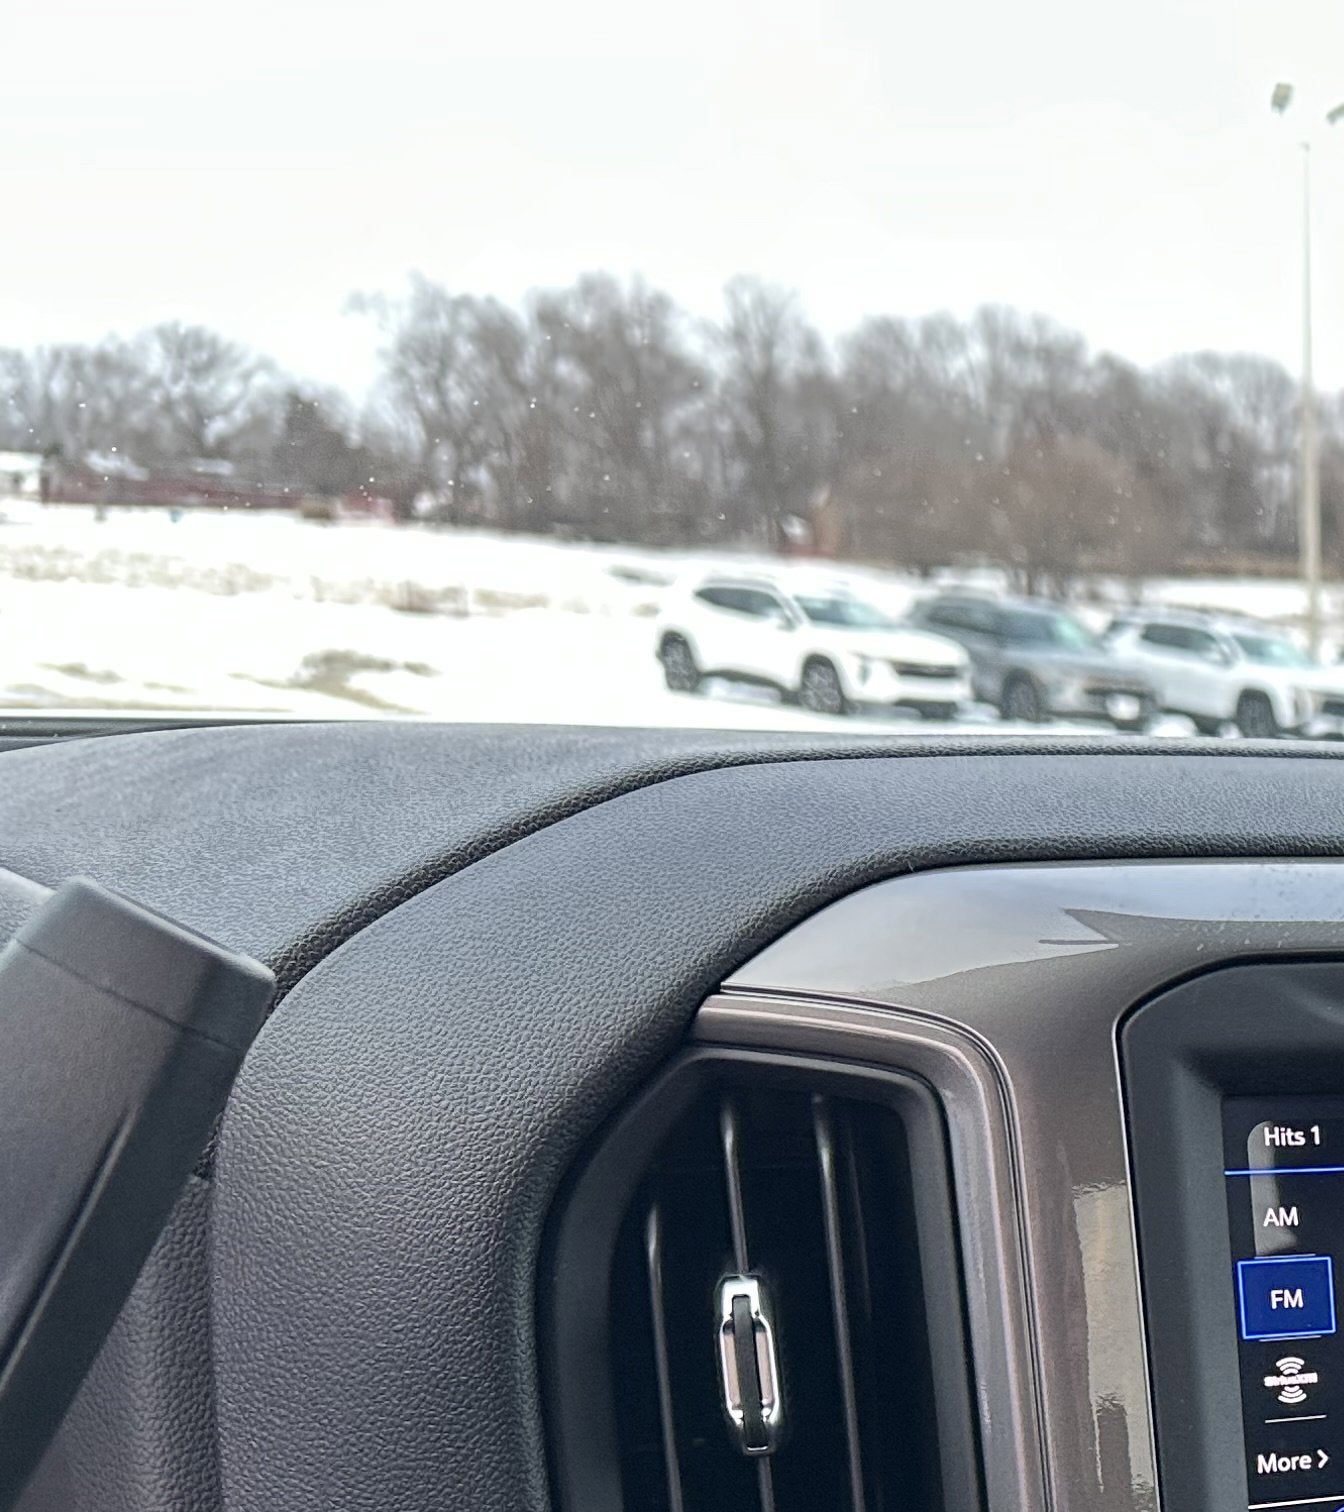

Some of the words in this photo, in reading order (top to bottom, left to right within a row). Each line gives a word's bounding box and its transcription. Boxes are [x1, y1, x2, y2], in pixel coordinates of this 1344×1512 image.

[1263, 1126, 1306, 1147] Hits
[1309, 1125, 1321, 1146] 1
[1262, 1206, 1300, 1227] AM
[1270, 1288, 1305, 1310] FM
[1256, 1452, 1313, 1475] More
